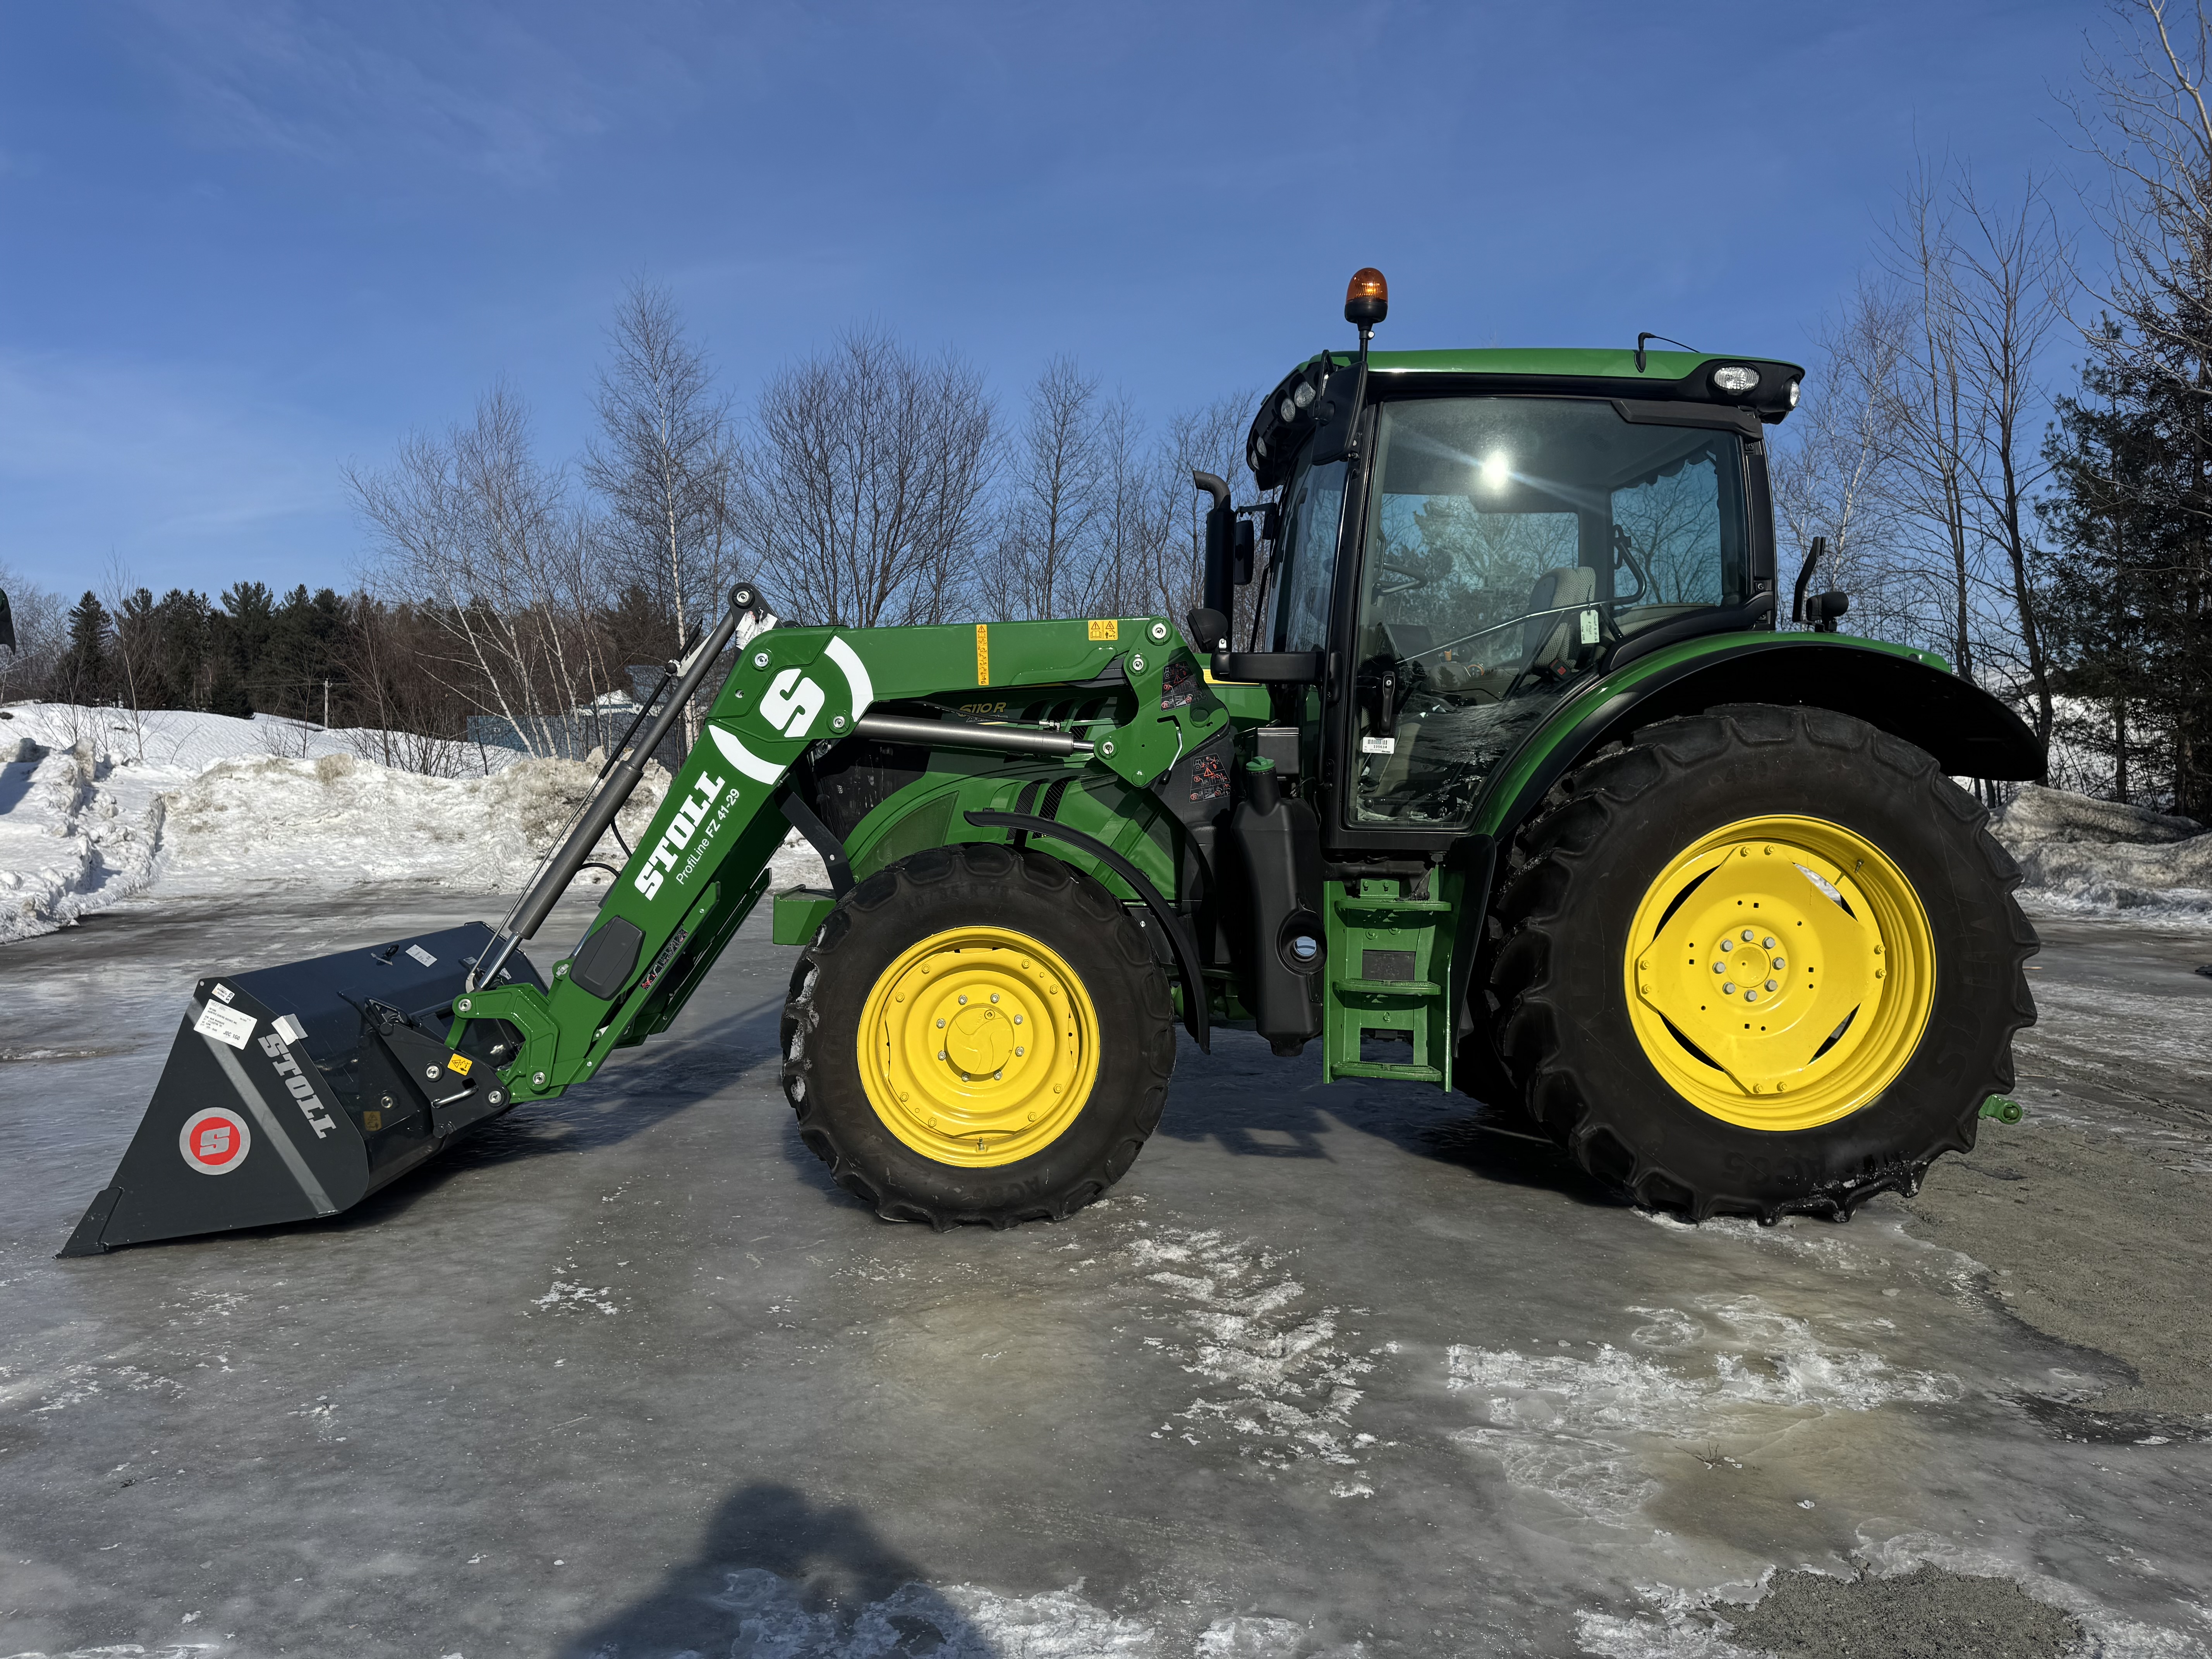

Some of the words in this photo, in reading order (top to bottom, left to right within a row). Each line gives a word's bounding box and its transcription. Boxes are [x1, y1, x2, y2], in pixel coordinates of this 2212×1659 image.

[634, 771, 725, 901] STOLL
[676, 838, 709, 885] ProfiLine
[705, 818, 721, 838] FZ
[717, 788, 740, 820] 41-29
[258, 1033, 337, 1139] STOLL
[200, 1126, 230, 1156] S
